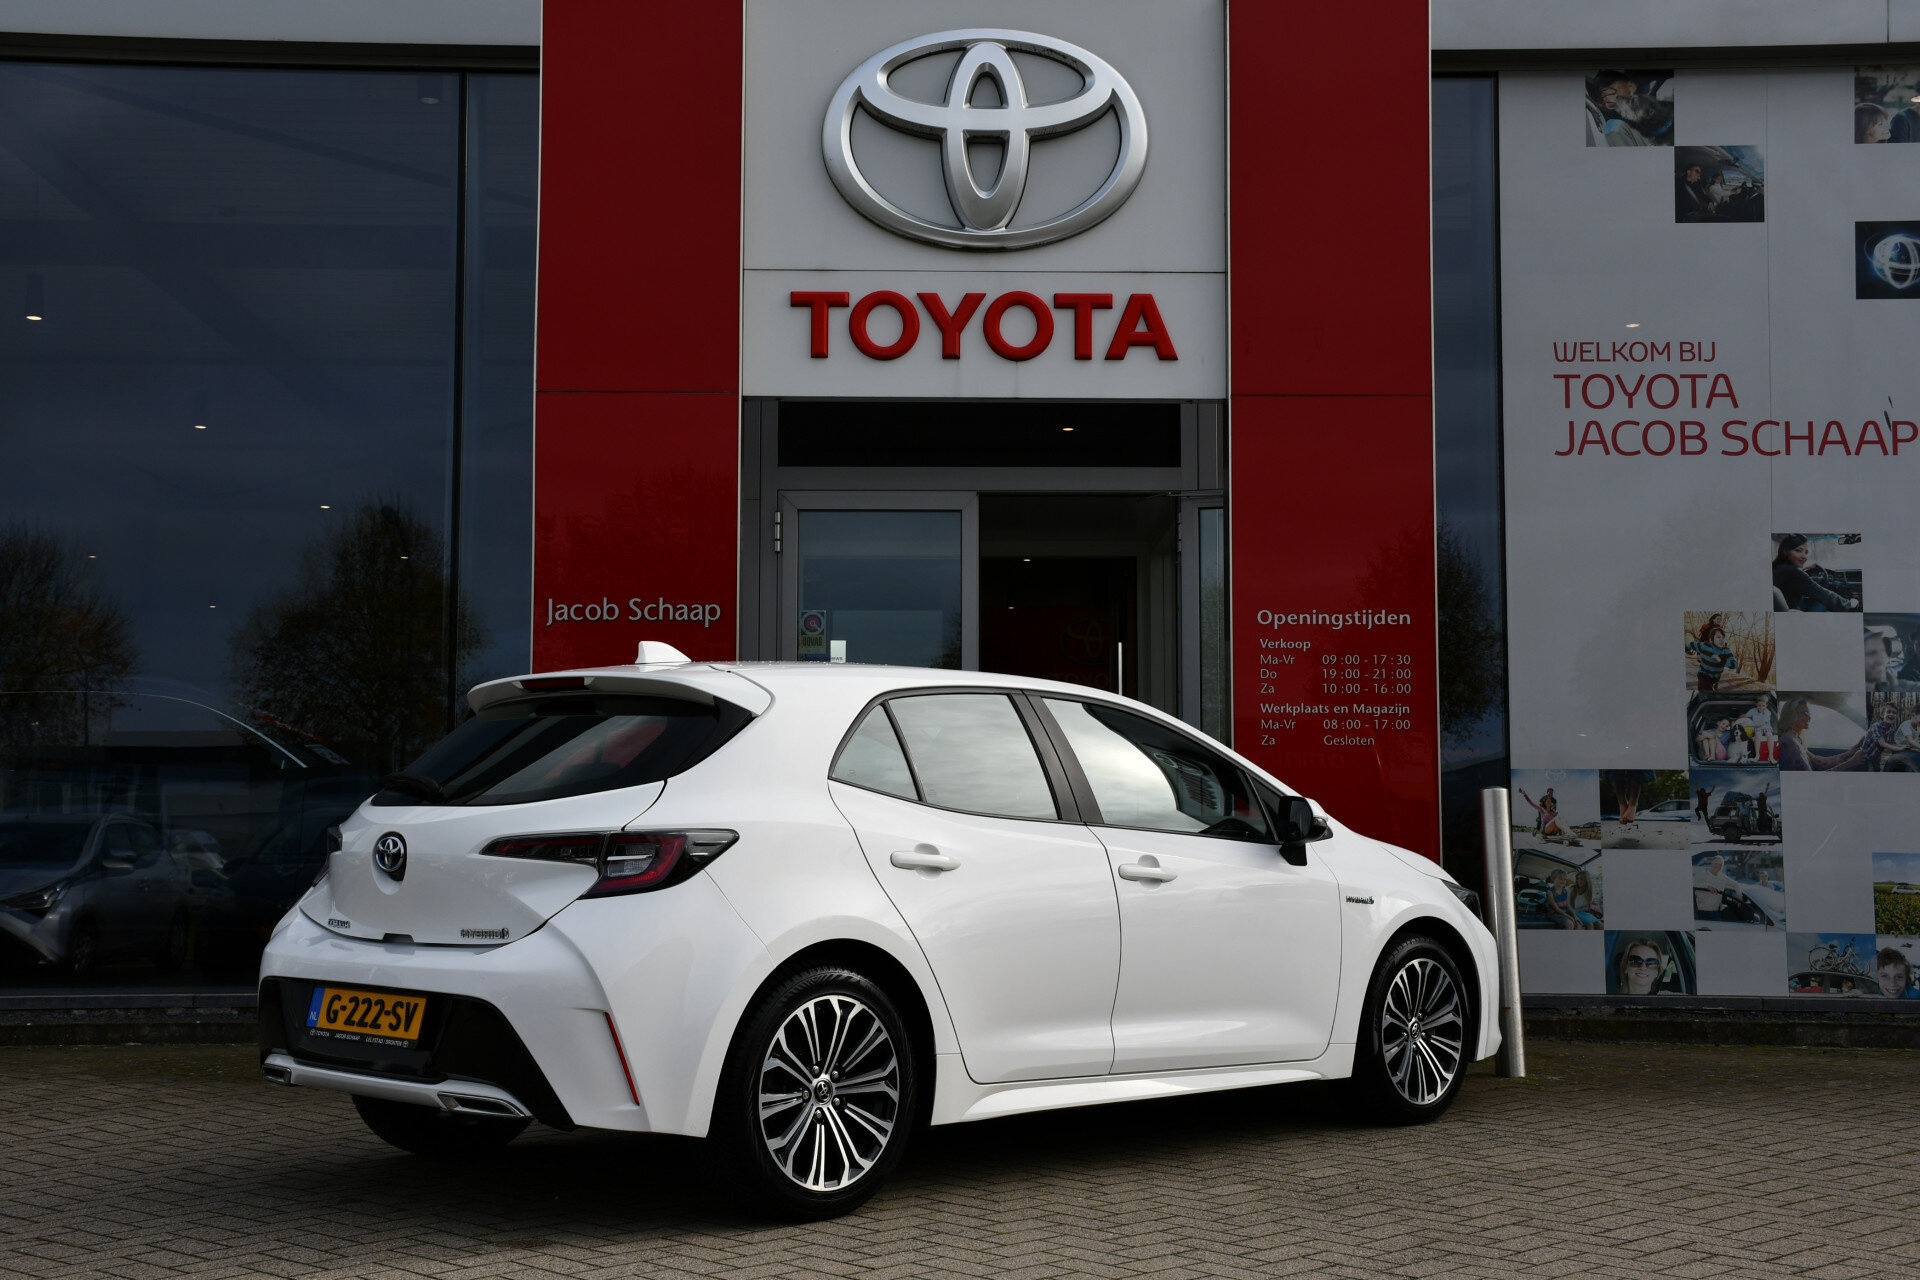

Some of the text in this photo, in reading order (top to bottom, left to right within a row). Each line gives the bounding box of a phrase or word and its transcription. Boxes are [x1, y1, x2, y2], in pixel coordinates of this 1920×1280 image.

[790, 290, 1178, 361] TOYOTA
[1553, 341, 1716, 362] WELKOM BIJ
[1553, 373, 1739, 409] TOYOTA
[1554, 420, 1919, 456] JACOB SCHAAP
[546, 597, 721, 627] Jacob Schaap
[1256, 609, 1411, 629] Openingstijden
[1259, 638, 1311, 651] Verkoop
[1260, 654, 1295, 665] Ma-Vr
[1260, 668, 1278, 679] Do
[1260, 683, 1275, 694] Za
[1260, 703, 1410, 717] Werkplaats en Magazijn
[1261, 719, 1297, 730] Ma-Vr
[1261, 735, 1375, 746] Za Gesloten
[309, 1011, 318, 1021] NL
[326, 994, 419, 1032] G-222-SV
